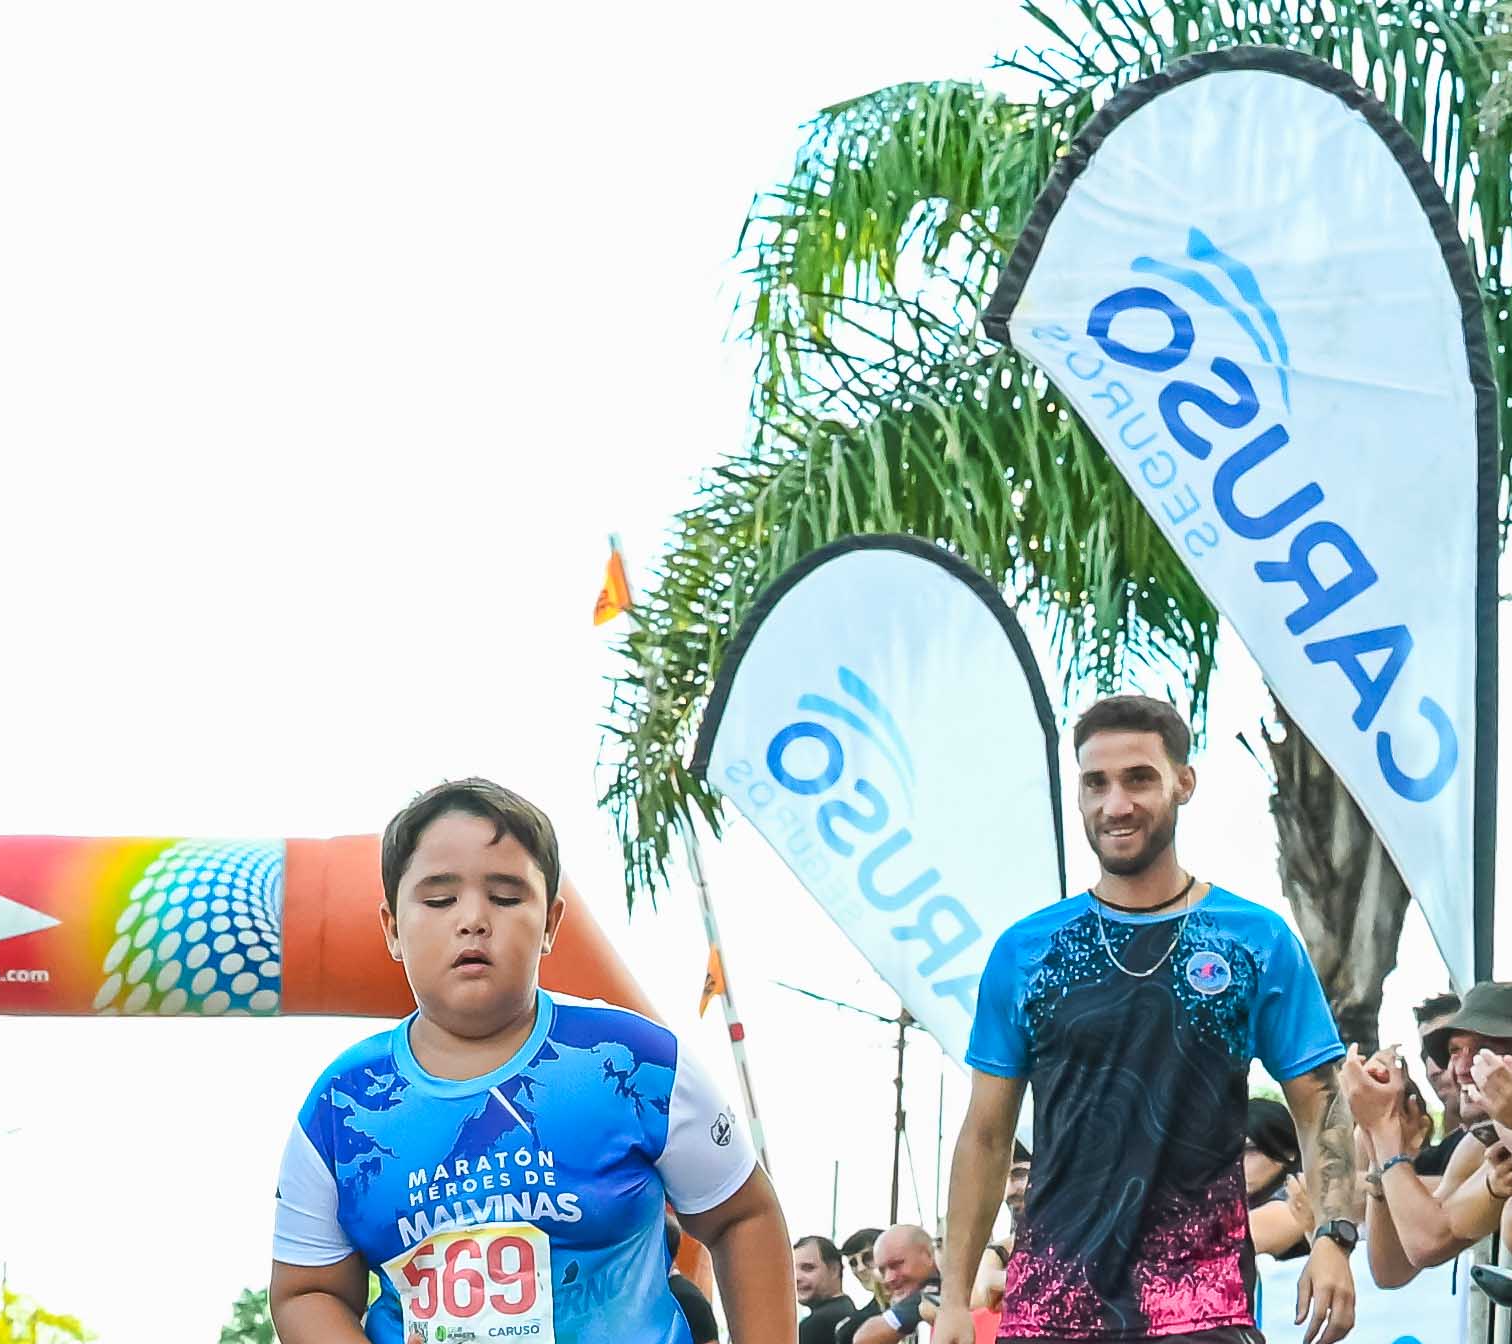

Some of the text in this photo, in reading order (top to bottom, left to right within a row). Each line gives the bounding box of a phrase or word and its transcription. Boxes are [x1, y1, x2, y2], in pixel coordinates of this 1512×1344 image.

[408, 1146, 554, 1189] MARATÓN
[410, 1170, 556, 1207] HÉROES DE
[397, 1191, 583, 1248] MALVINAS
[402, 1235, 537, 1319] 569
[488, 1324, 540, 1337] CARUSO
